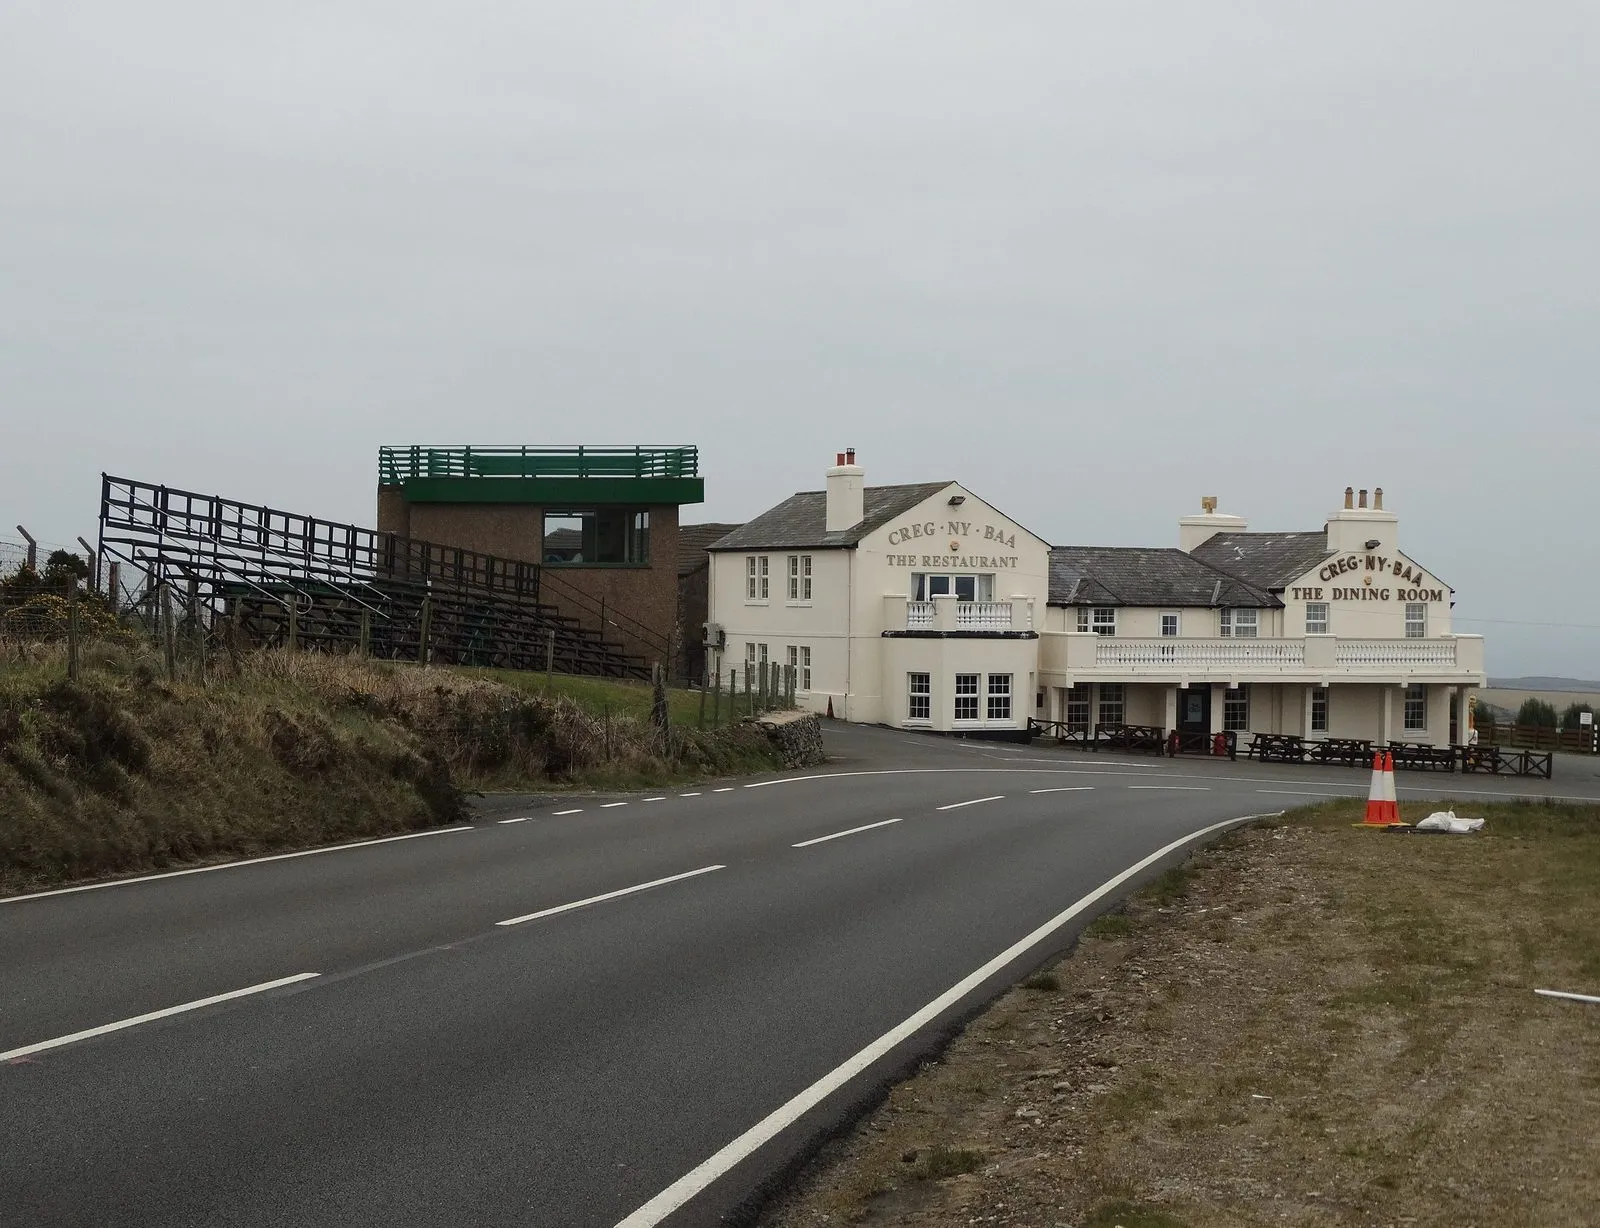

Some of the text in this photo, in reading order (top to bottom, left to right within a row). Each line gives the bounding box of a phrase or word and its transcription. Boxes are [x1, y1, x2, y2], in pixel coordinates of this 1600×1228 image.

[888, 521, 1015, 548] CREG NY BAA
[887, 555, 1018, 568] THE RESTAURANT
[1319, 555, 1423, 587] CREG NY BAA
[1292, 587, 1443, 601] THE DINING ROOM
